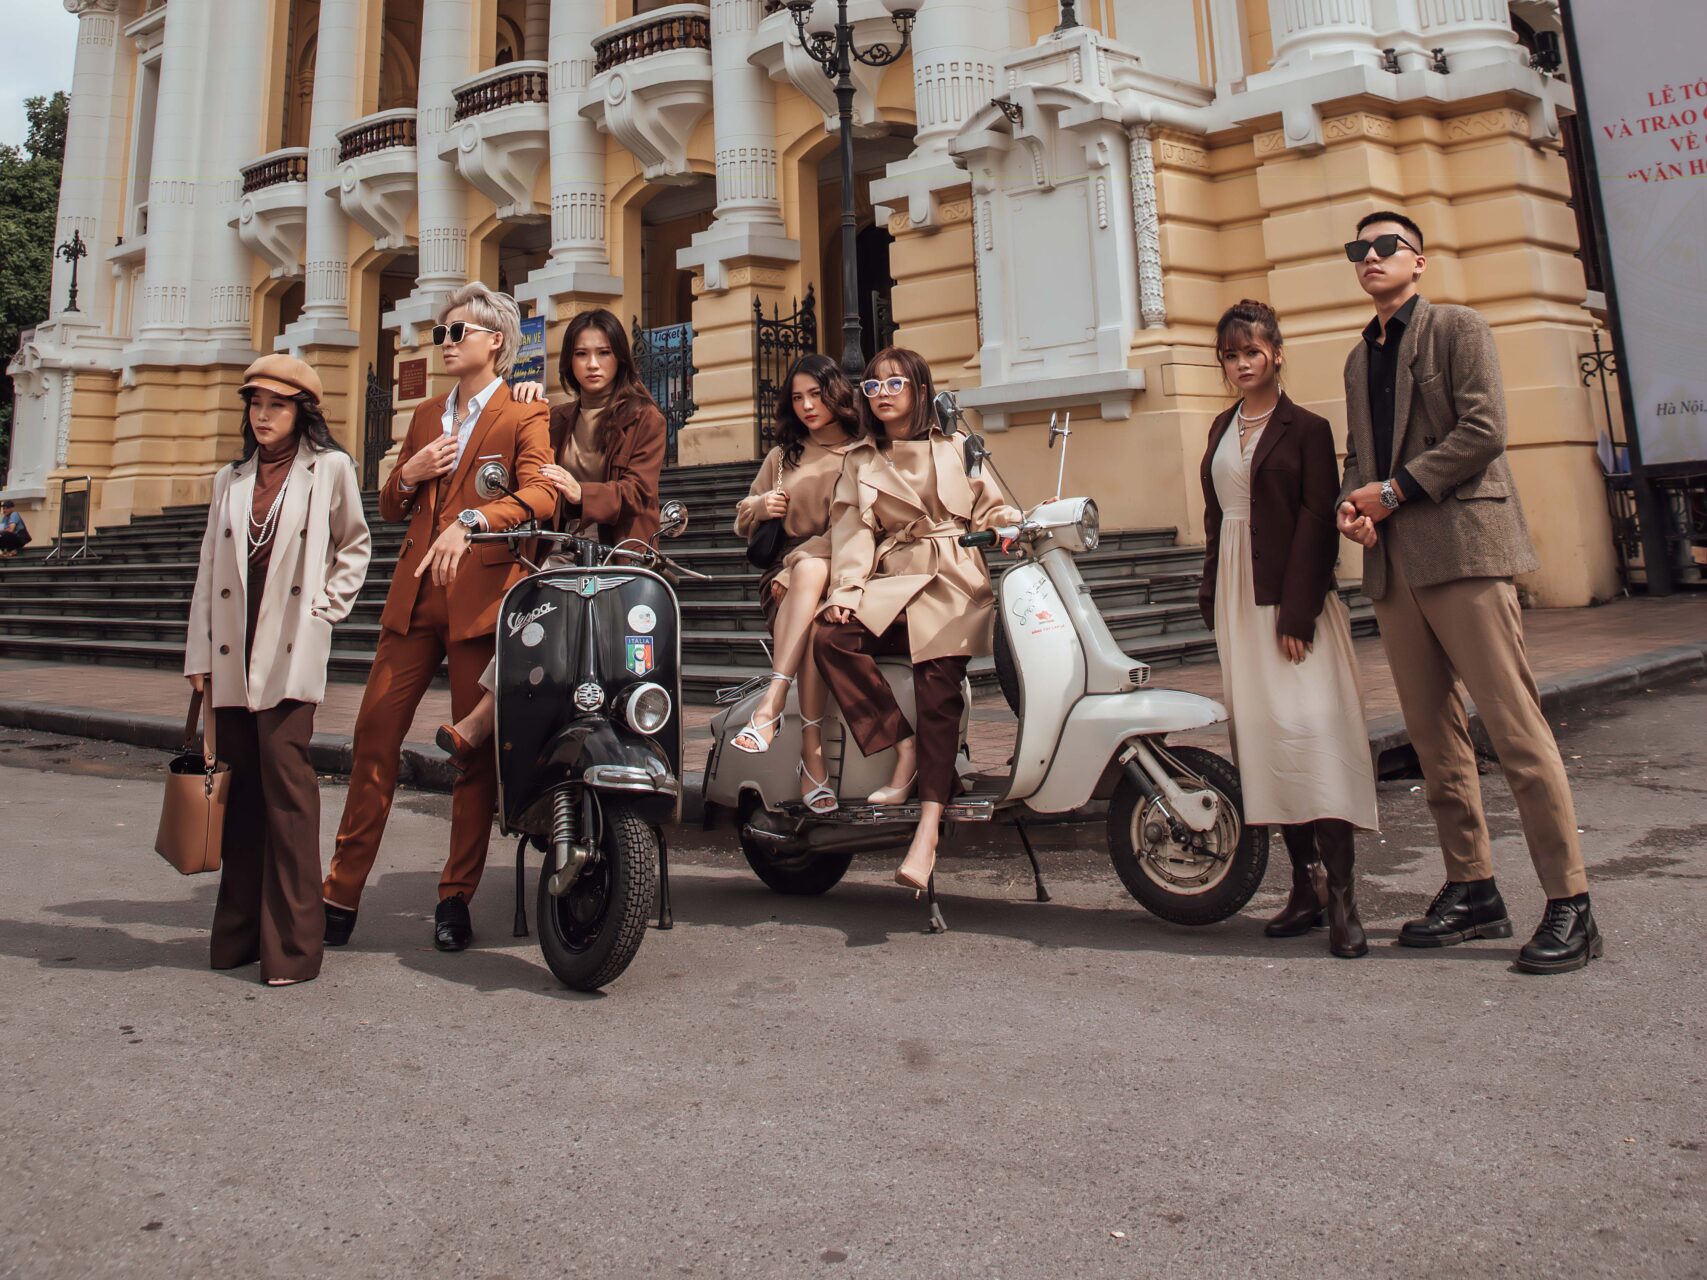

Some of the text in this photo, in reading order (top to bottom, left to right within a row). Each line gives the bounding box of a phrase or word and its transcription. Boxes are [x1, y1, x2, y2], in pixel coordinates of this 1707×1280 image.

[1603, 118, 1633, 141] VÀ
[1635, 109, 1698, 135] TRAO
[653, 328, 681, 342] Ticket
[1656, 401, 1677, 417] Hà
